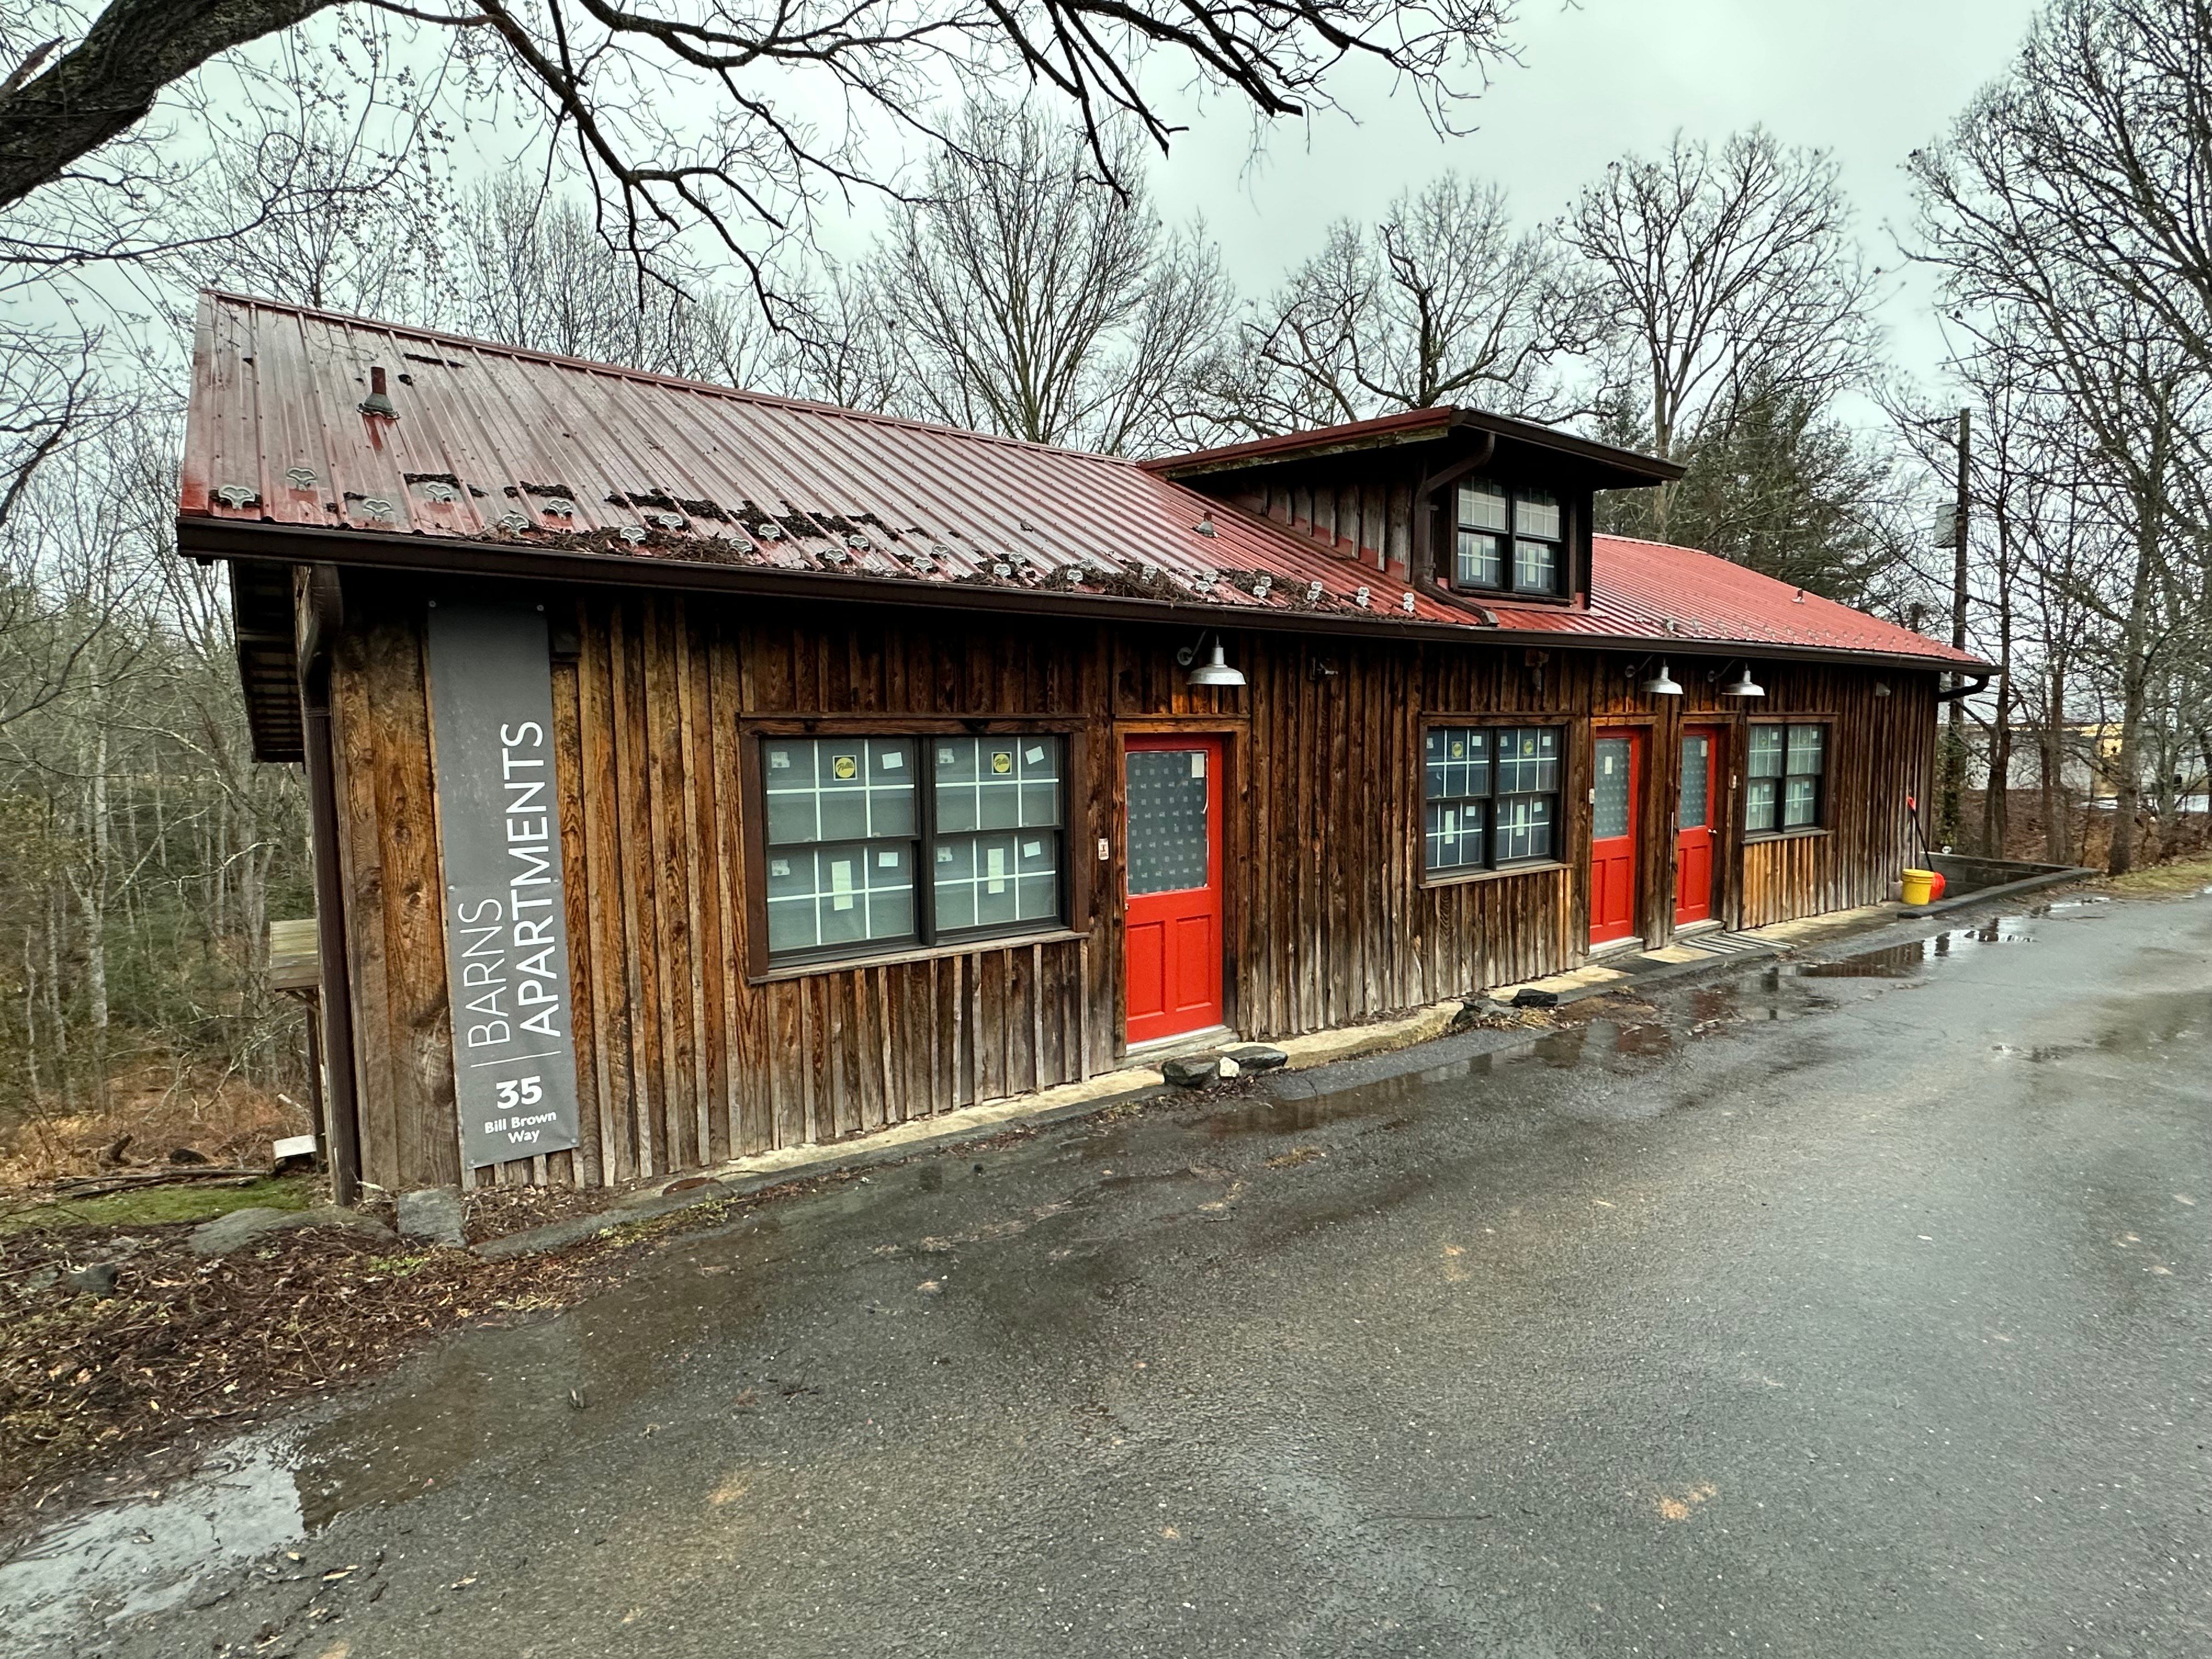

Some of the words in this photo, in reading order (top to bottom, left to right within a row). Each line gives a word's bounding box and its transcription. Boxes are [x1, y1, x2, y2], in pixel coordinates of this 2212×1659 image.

[500, 721, 561, 1037] APARTMENTS
[458, 899, 510, 1048] BARNS
[496, 1075, 542, 1109] 35
[484, 1118, 507, 1134] Bill
[511, 1111, 557, 1129] Brown
[507, 1130, 540, 1144] Way
